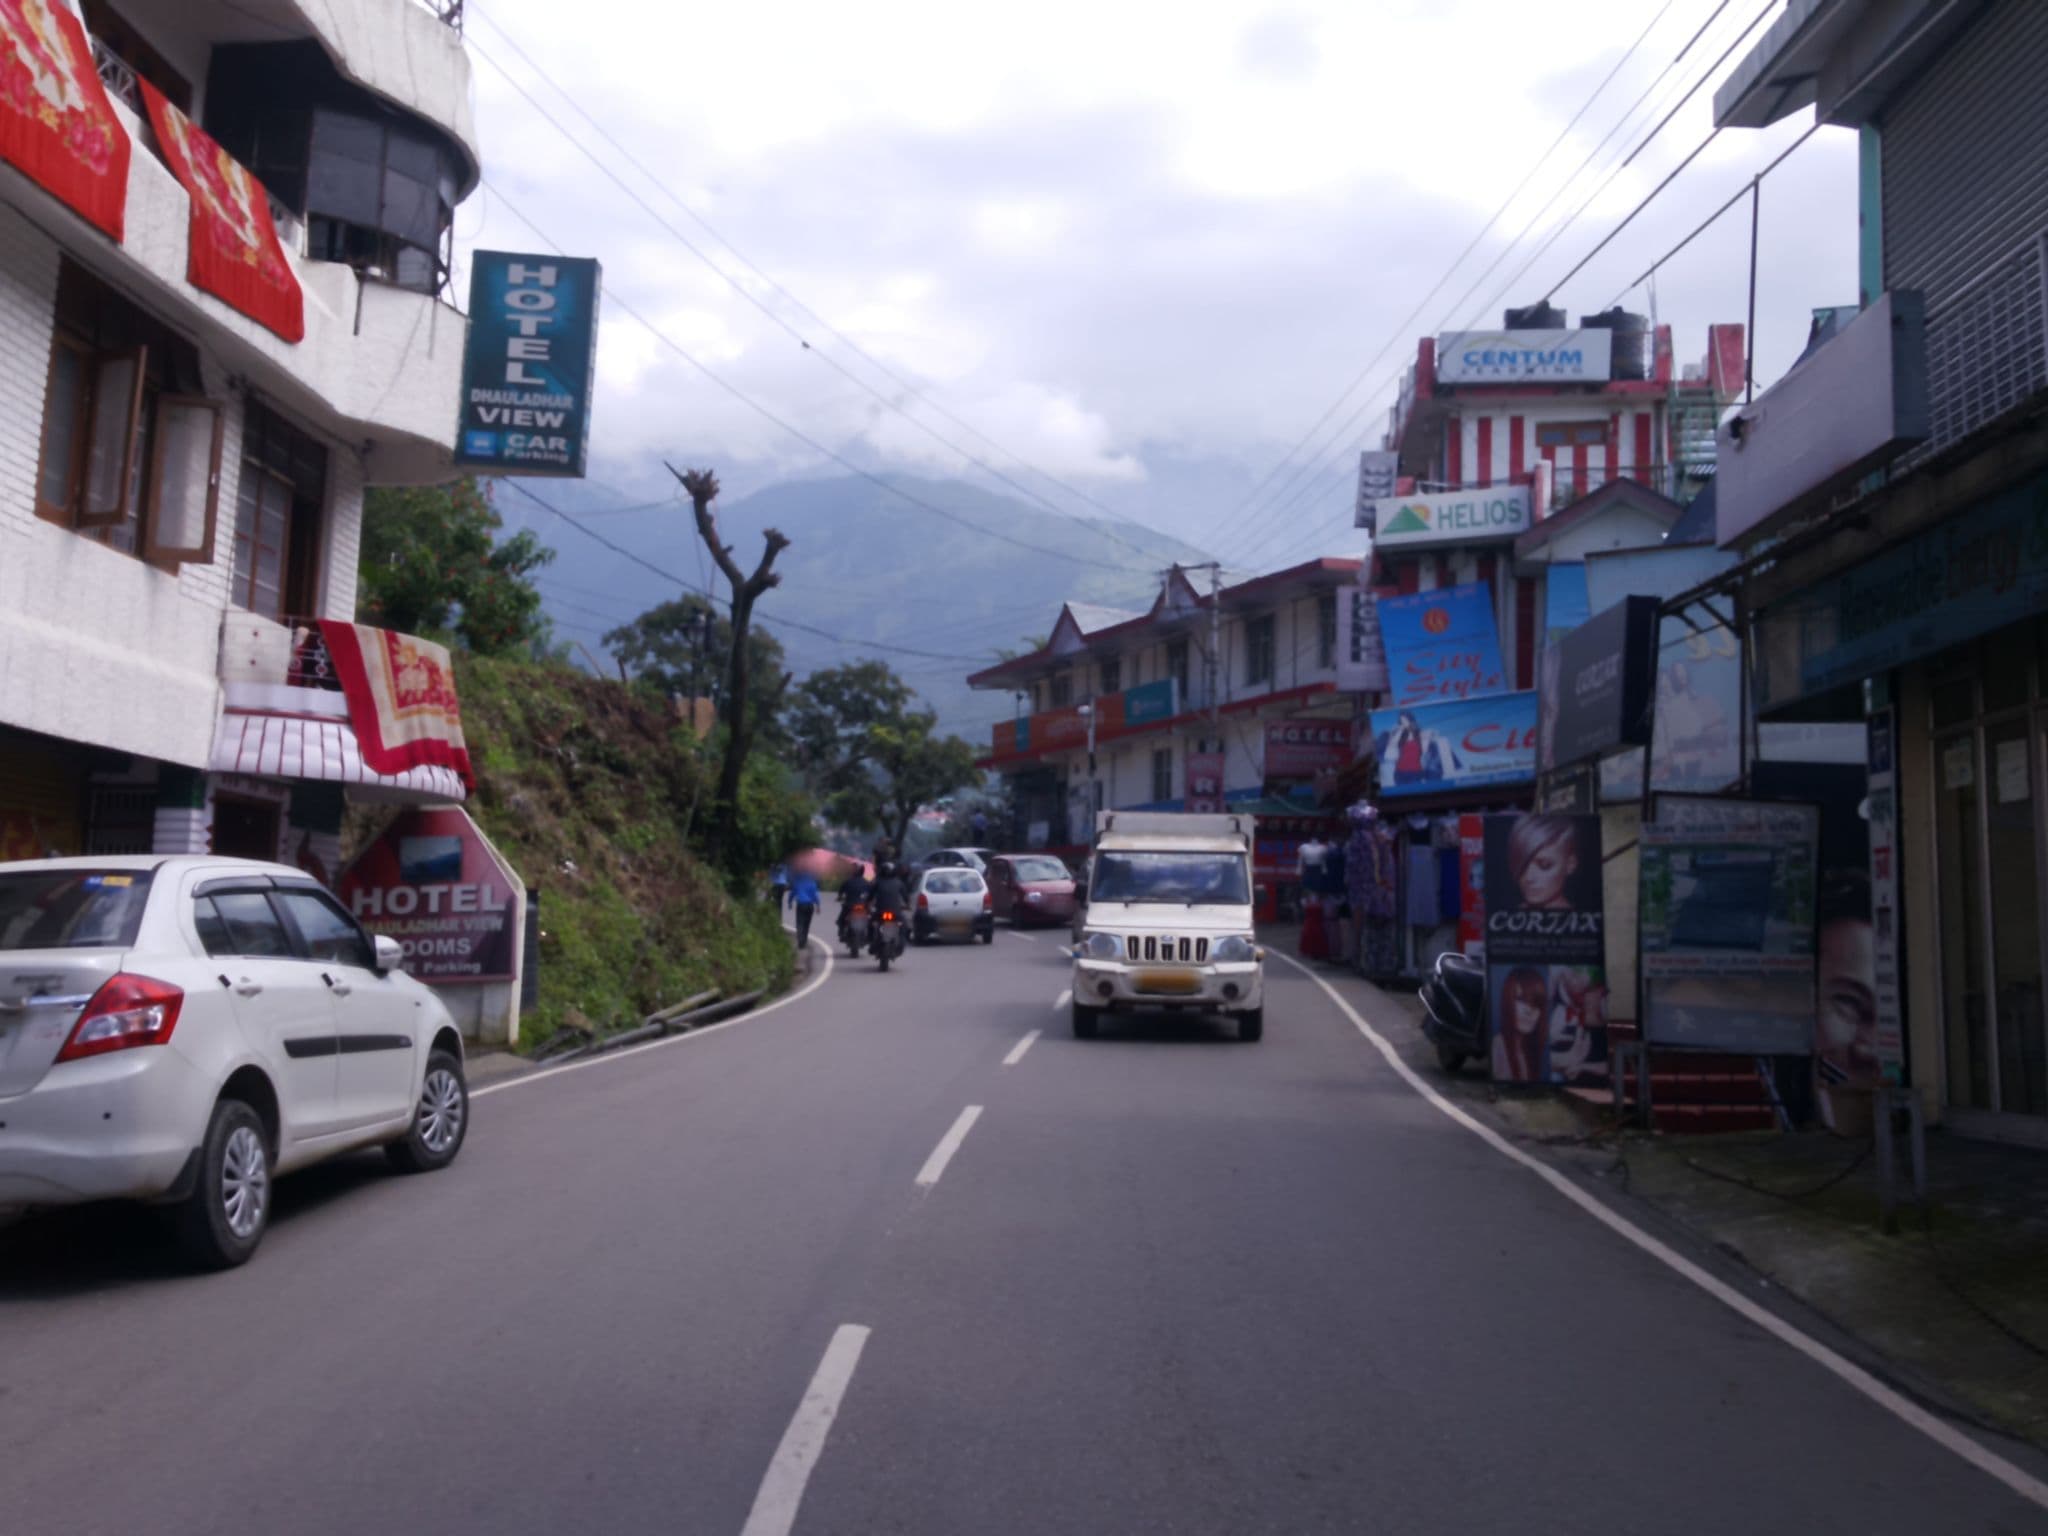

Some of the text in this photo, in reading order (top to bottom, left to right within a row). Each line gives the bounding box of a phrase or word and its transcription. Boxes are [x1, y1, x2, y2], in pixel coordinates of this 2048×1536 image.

[504, 263, 558, 385] HOTEL
[1463, 350, 1582, 367] CENTUM
[477, 406, 565, 428] VIEW
[507, 433, 568, 451] CAR
[503, 447, 569, 465] Parking
[1437, 499, 1522, 531] HELIOS
[1268, 726, 1345, 744] HOTEL
[352, 885, 505, 916] HOTEL
[402, 938, 472, 957] OOMS
[423, 962, 482, 974] Parking
